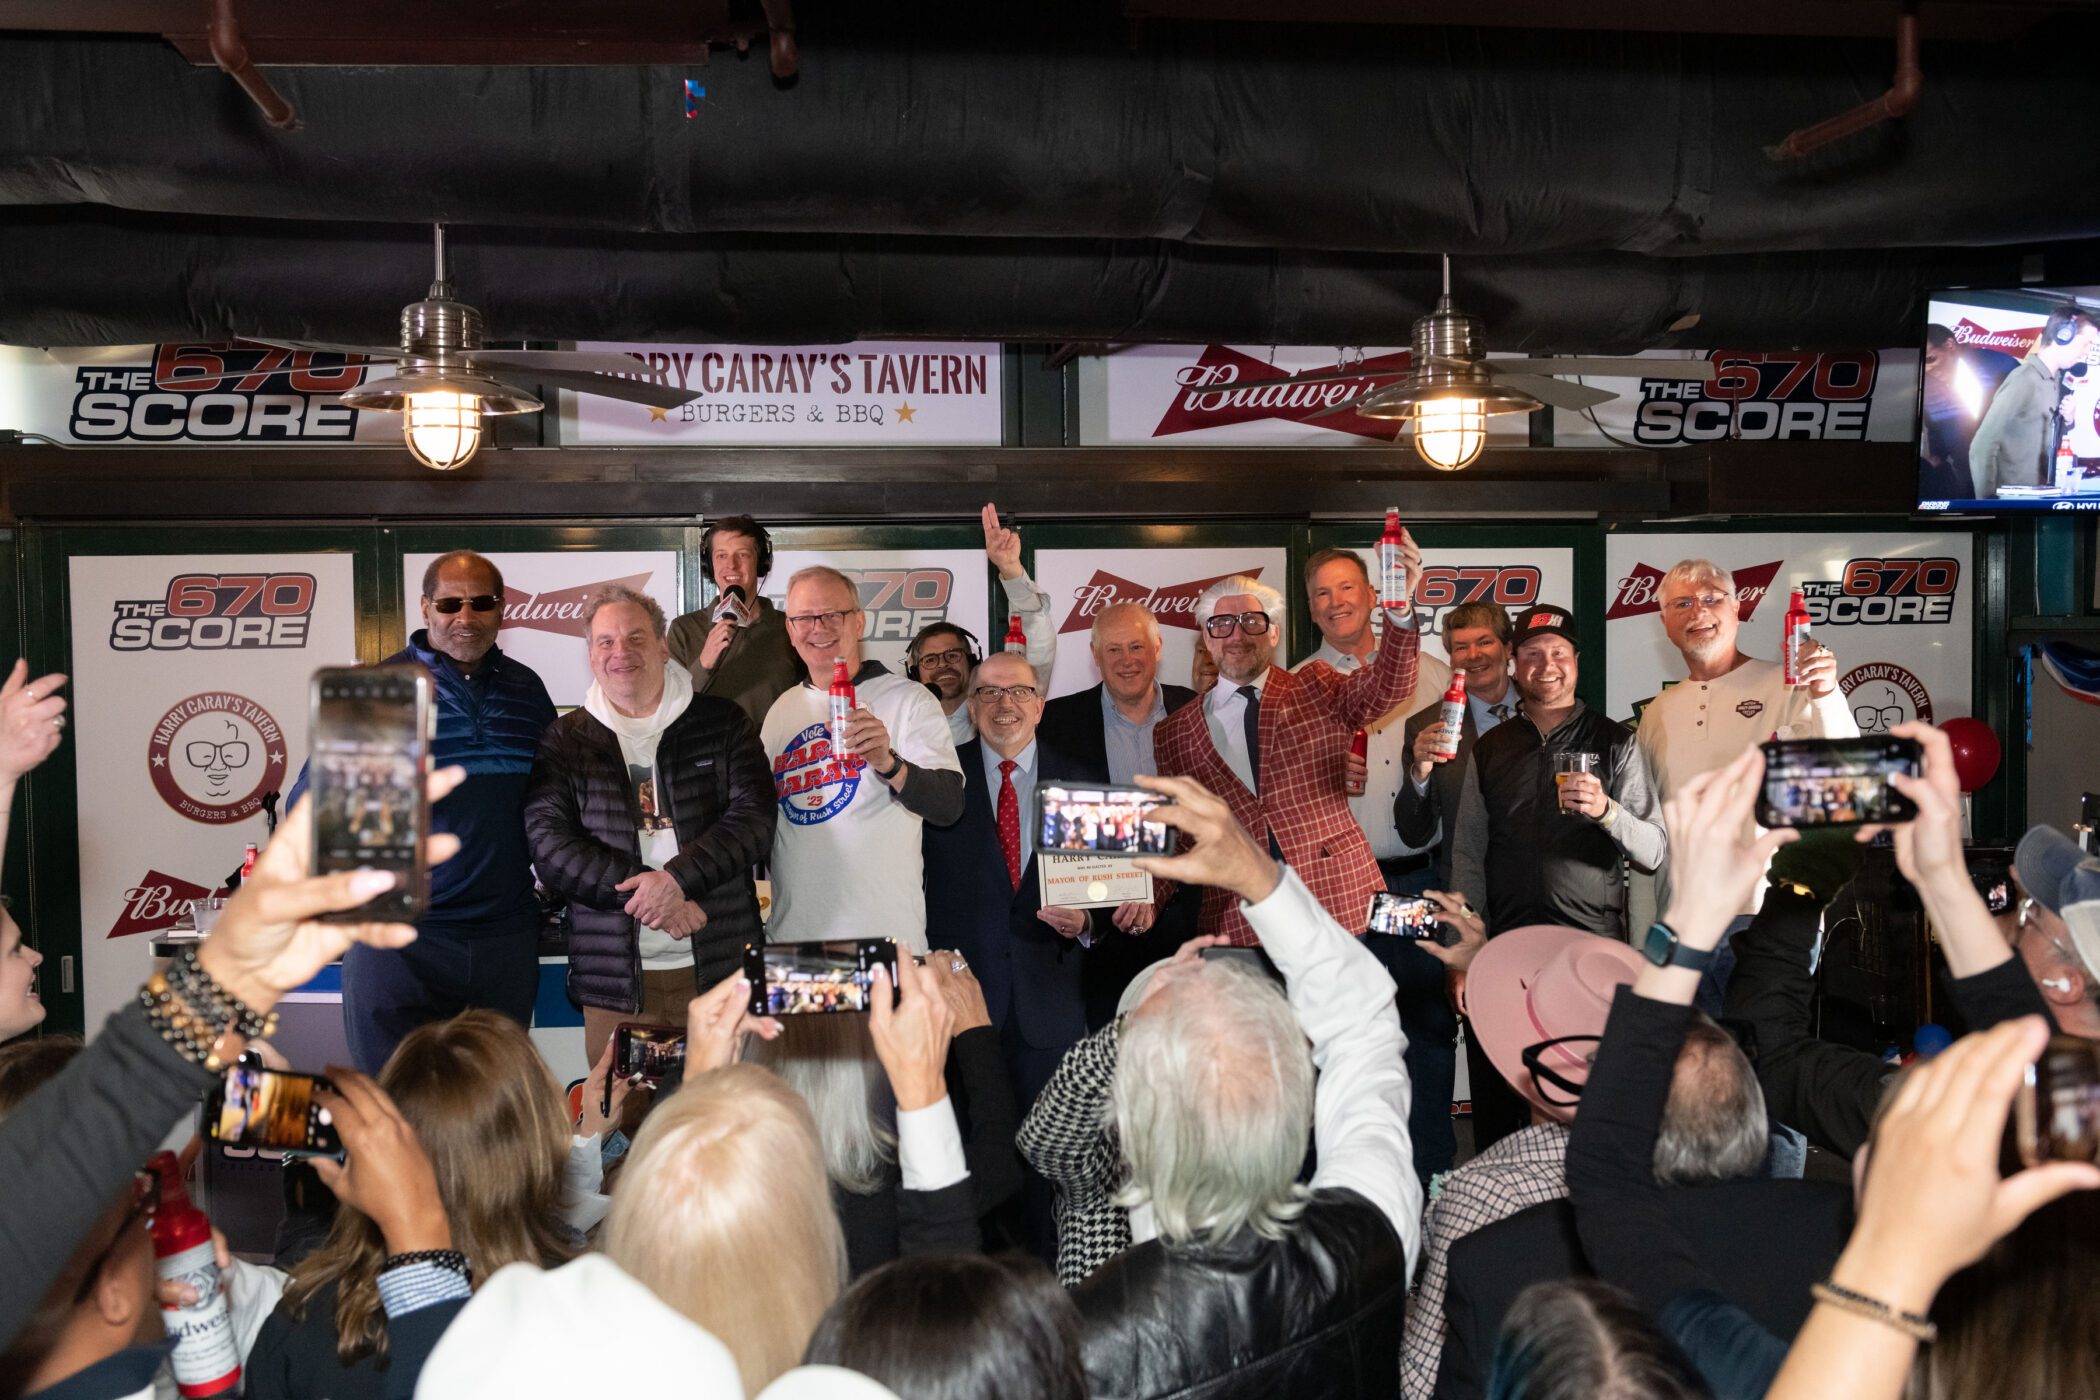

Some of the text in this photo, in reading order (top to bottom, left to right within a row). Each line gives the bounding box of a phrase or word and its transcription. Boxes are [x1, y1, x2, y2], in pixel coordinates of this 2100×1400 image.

[1951, 325, 2034, 348] Budweiser
[82, 344, 362, 391] THE 670
[702, 352, 851, 394] CARAY'S
[858, 354, 986, 394] TAVERN
[1645, 350, 1874, 400] THE 670
[75, 393, 352, 436] SCORE
[680, 404, 884, 425] BURGERS & BBQ
[1638, 401, 1867, 440] SCORE
[118, 575, 314, 617] THE 670
[847, 570, 951, 609] 70
[1415, 568, 1540, 605] 670
[1805, 560, 1958, 597] THE 670
[1803, 597, 1952, 622] SCORE
[113, 616, 307, 648] SCORE
[1855, 665, 1899, 682] CARAY'S
[1898, 671, 1929, 708] TAVERN
[154, 695, 280, 746] HARRY CARAY'S TAVERN
[802, 725, 824, 741] Vote
[773, 740, 832, 774] HAR
[179, 797, 262, 819] BURGERS & BBQ
[800, 813, 808, 823] of
[810, 808, 833, 820] Rush
[833, 783, 853, 809] Street
[1048, 877, 1075, 885] MAYOR
[1116, 871, 1144, 879] STREET
